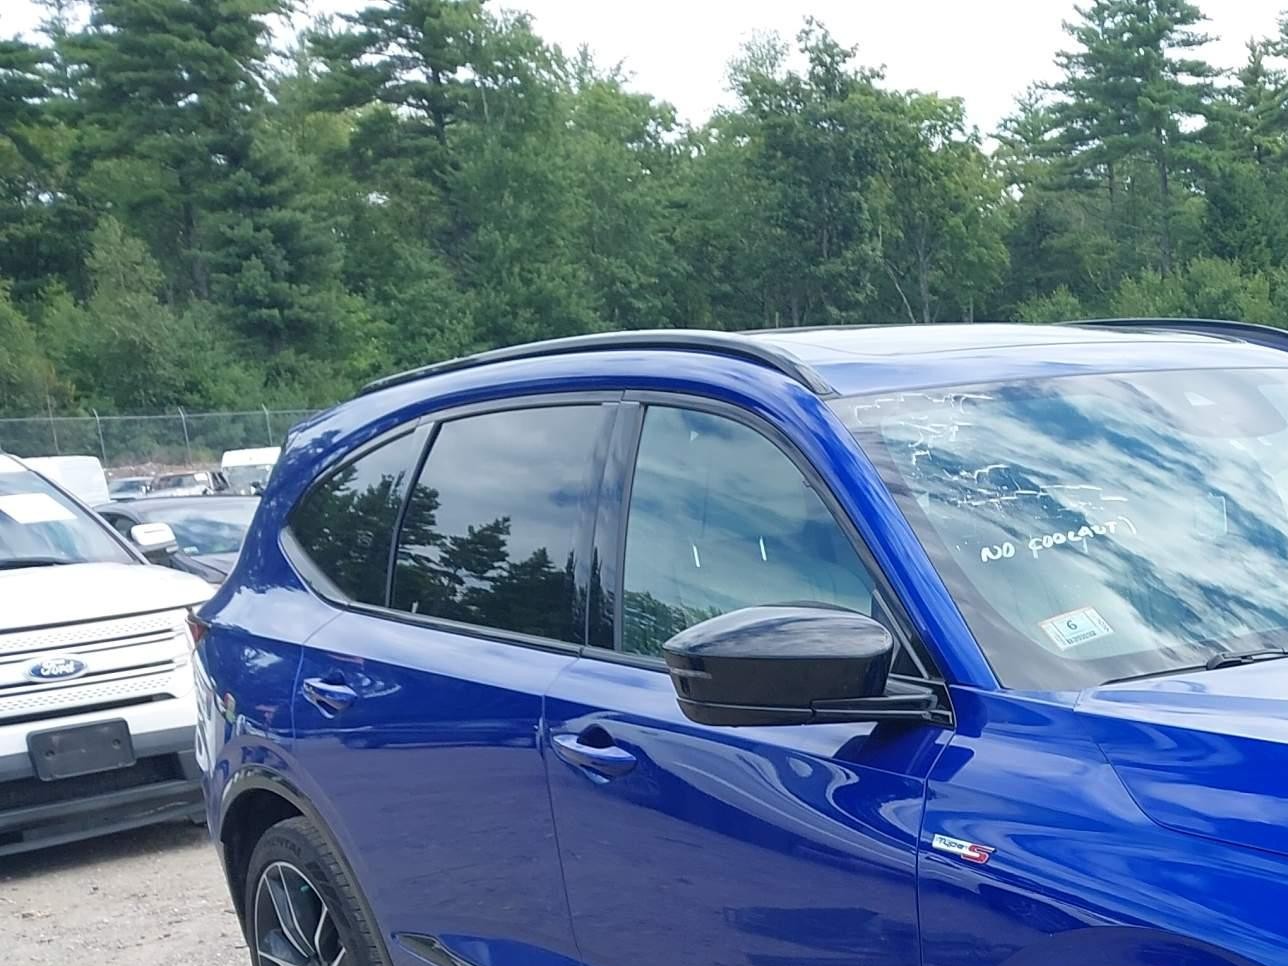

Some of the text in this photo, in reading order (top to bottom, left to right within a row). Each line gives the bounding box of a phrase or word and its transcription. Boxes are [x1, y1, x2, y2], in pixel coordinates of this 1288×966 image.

[981, 541, 1016, 562] NO
[1066, 619, 1078, 631] 6
[40, 659, 75, 676] Ford
[960, 843, 995, 864] S
